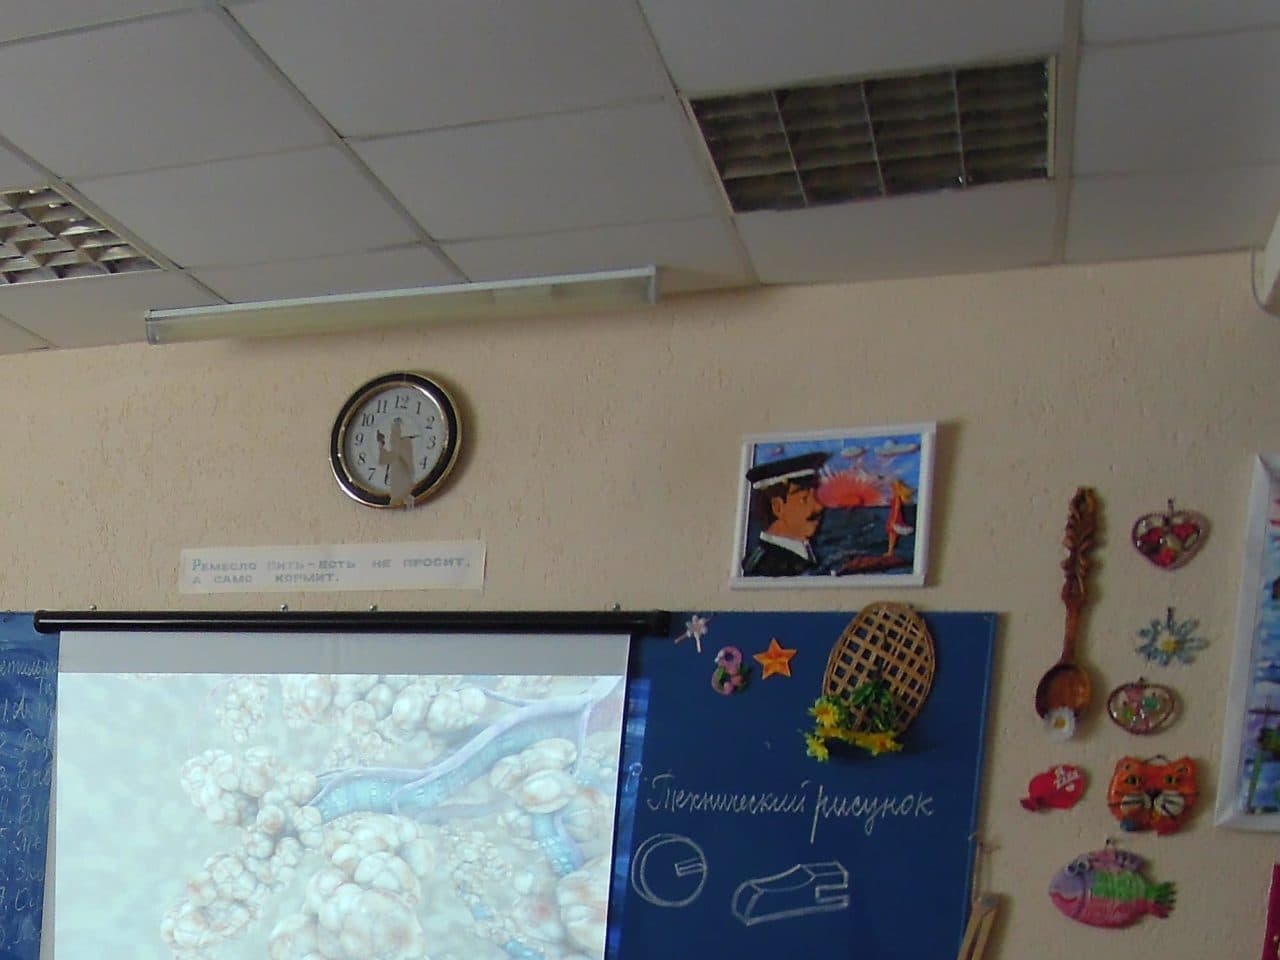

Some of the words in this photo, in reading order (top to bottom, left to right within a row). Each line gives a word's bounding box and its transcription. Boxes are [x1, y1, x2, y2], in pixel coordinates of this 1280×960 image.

[376, 400, 388, 414] 11
[394, 395, 409, 409] 12
[361, 413, 375, 427] 10
[424, 415, 436, 430] 2
[354, 432, 365, 446] 9
[426, 435, 437, 449] 3
[357, 452, 367, 465] 8
[368, 467, 377, 481] 7
[810, 783, 935, 844] рисунок
